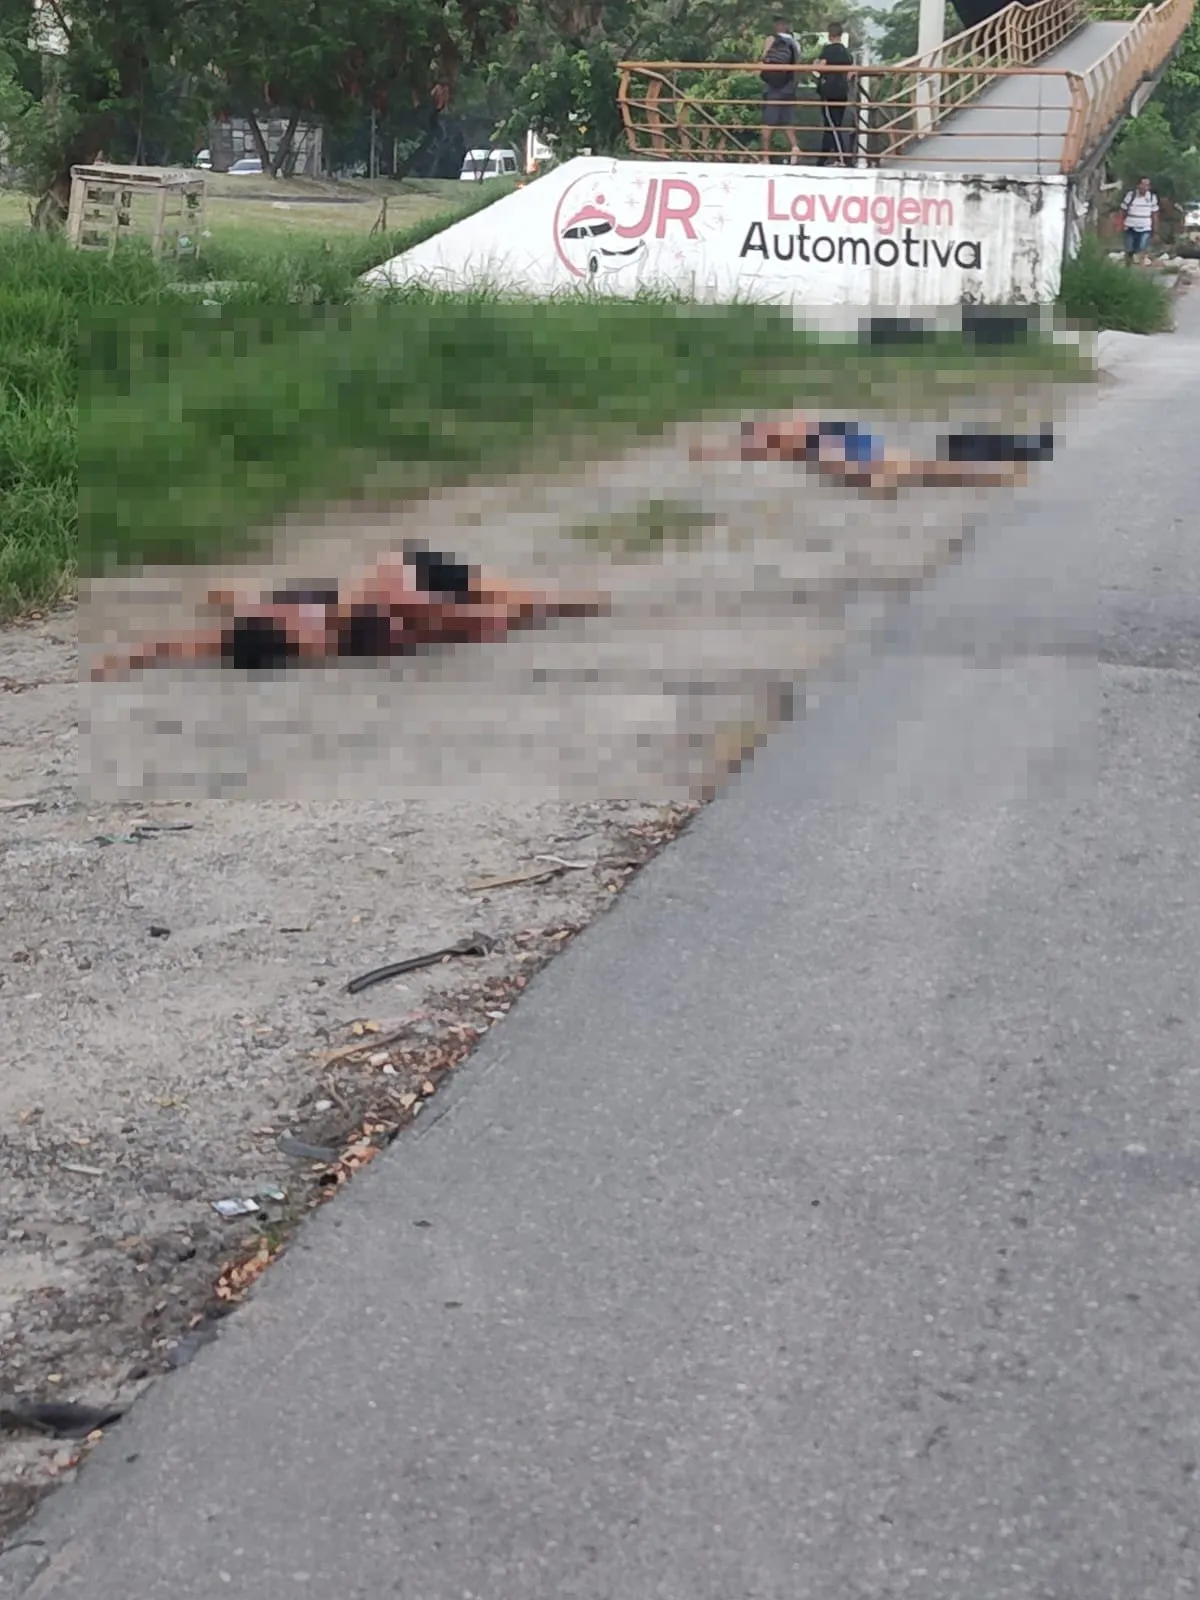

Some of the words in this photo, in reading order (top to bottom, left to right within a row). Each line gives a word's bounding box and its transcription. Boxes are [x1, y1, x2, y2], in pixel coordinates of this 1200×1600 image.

[615, 178, 701, 239] JR
[767, 179, 954, 235] Lavagem
[739, 221, 982, 270] Automotiva
